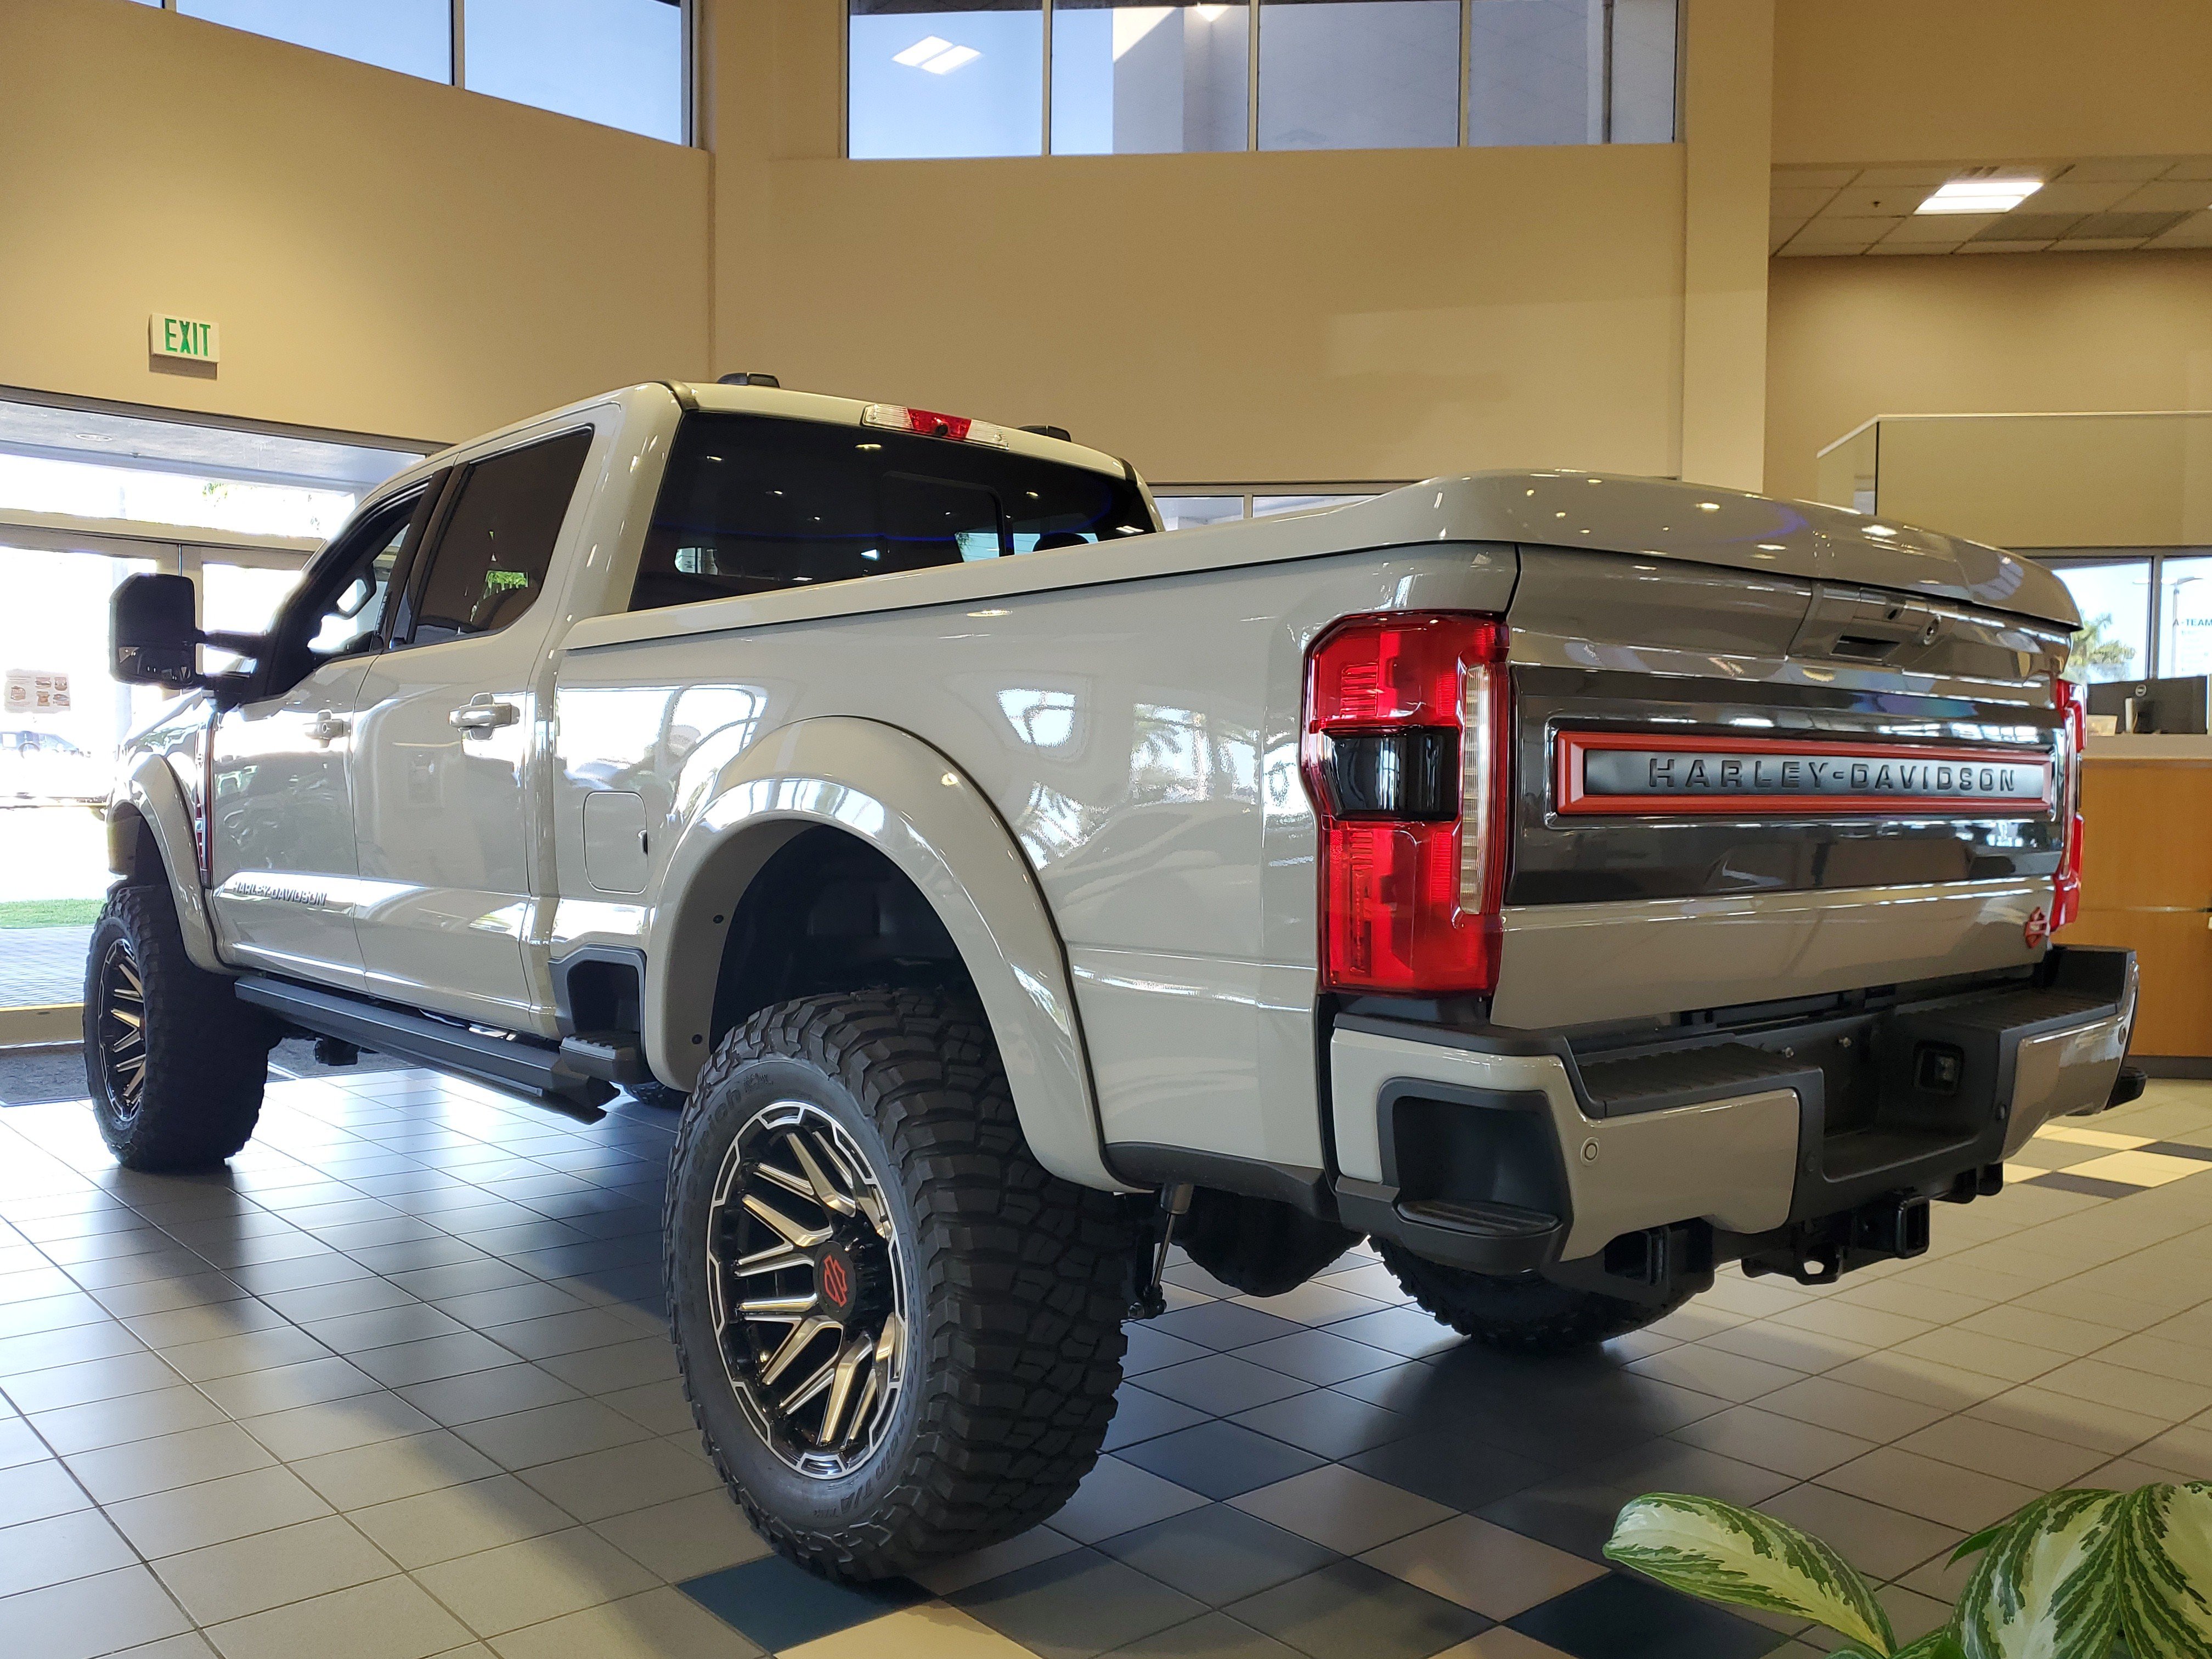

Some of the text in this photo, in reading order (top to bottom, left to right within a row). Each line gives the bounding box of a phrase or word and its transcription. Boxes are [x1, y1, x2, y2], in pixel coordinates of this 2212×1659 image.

[165, 318, 211, 357] EXIT
[1649, 758, 2015, 792] HARLEY-DAVIDSON
[232, 882, 327, 906] HARLEY-DAVIDSON
